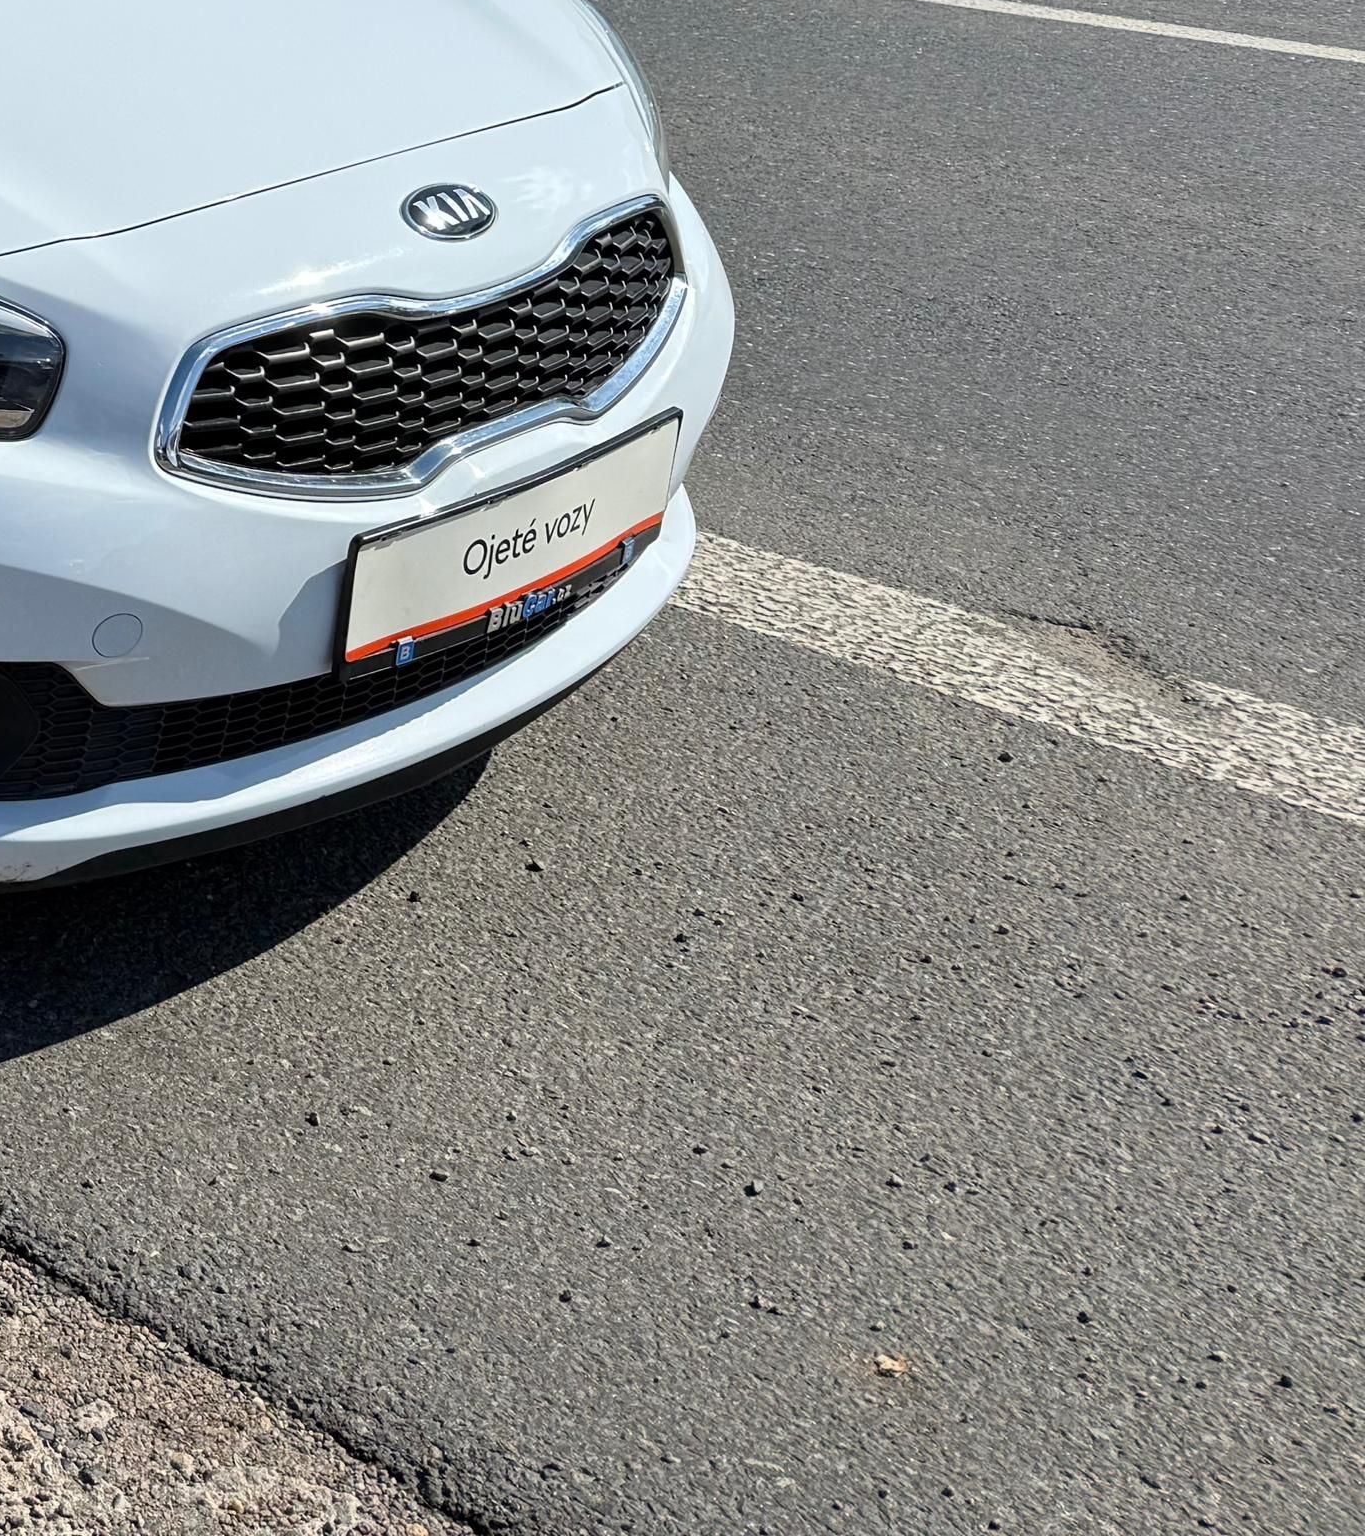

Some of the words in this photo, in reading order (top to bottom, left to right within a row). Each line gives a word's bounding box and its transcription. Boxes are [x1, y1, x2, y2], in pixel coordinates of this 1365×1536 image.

[412, 188, 491, 231] KIA
[462, 519, 537, 580] Ojeté
[544, 498, 596, 545] vozy
